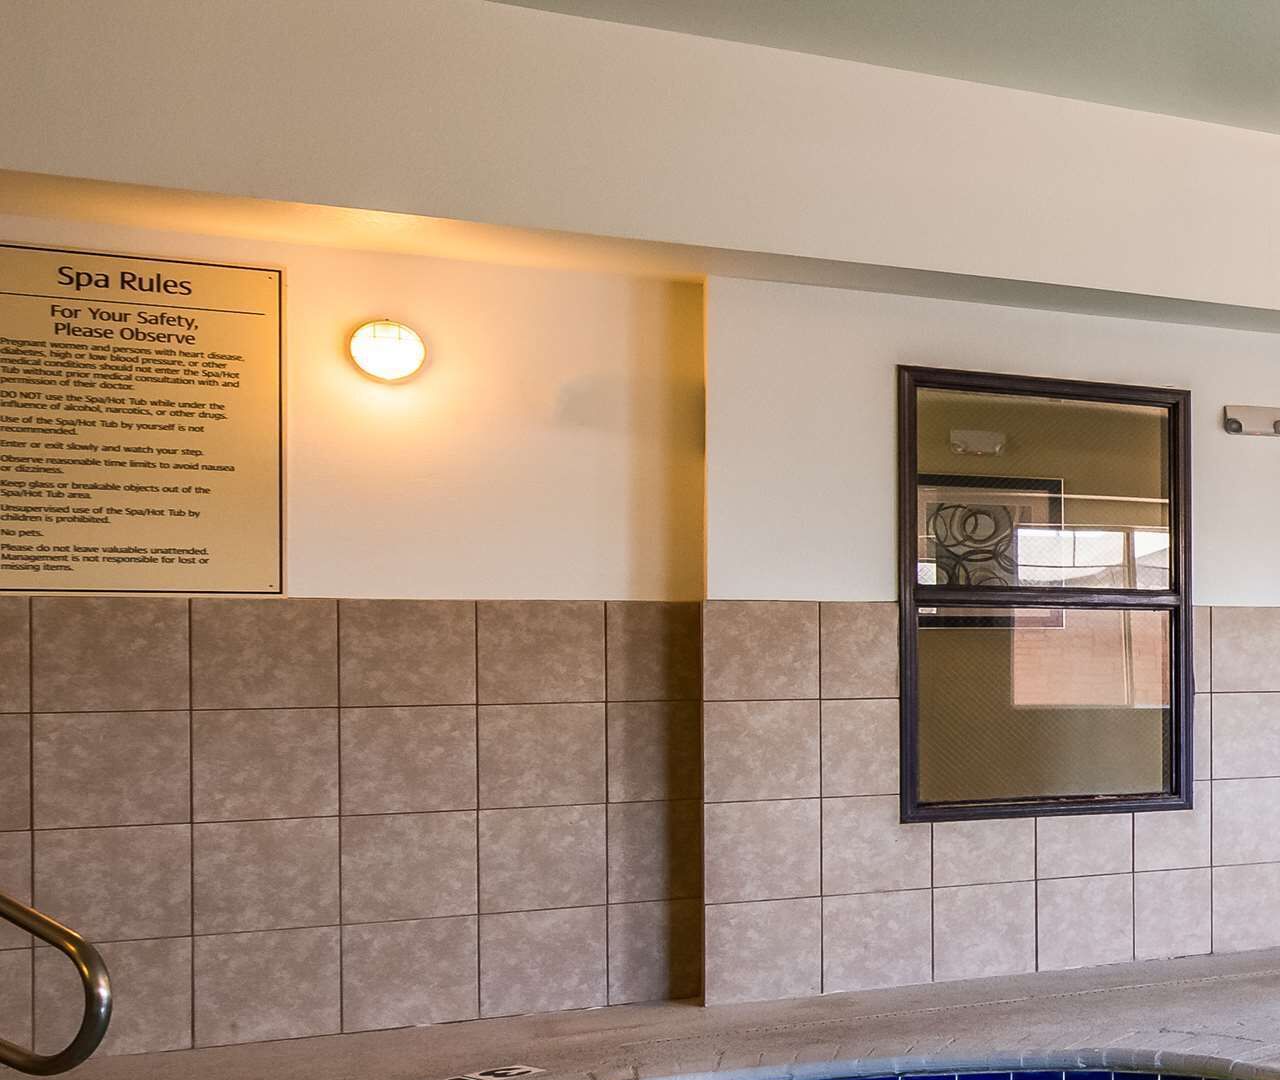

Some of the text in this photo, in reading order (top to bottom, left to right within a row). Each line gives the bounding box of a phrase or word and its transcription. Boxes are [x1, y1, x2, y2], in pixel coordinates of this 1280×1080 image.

[57, 266, 192, 295] Spa Rules
[51, 305, 199, 330] For Your Safety,
[54, 323, 195, 344] Please Observe
[479, 1067, 532, 1078] 3
